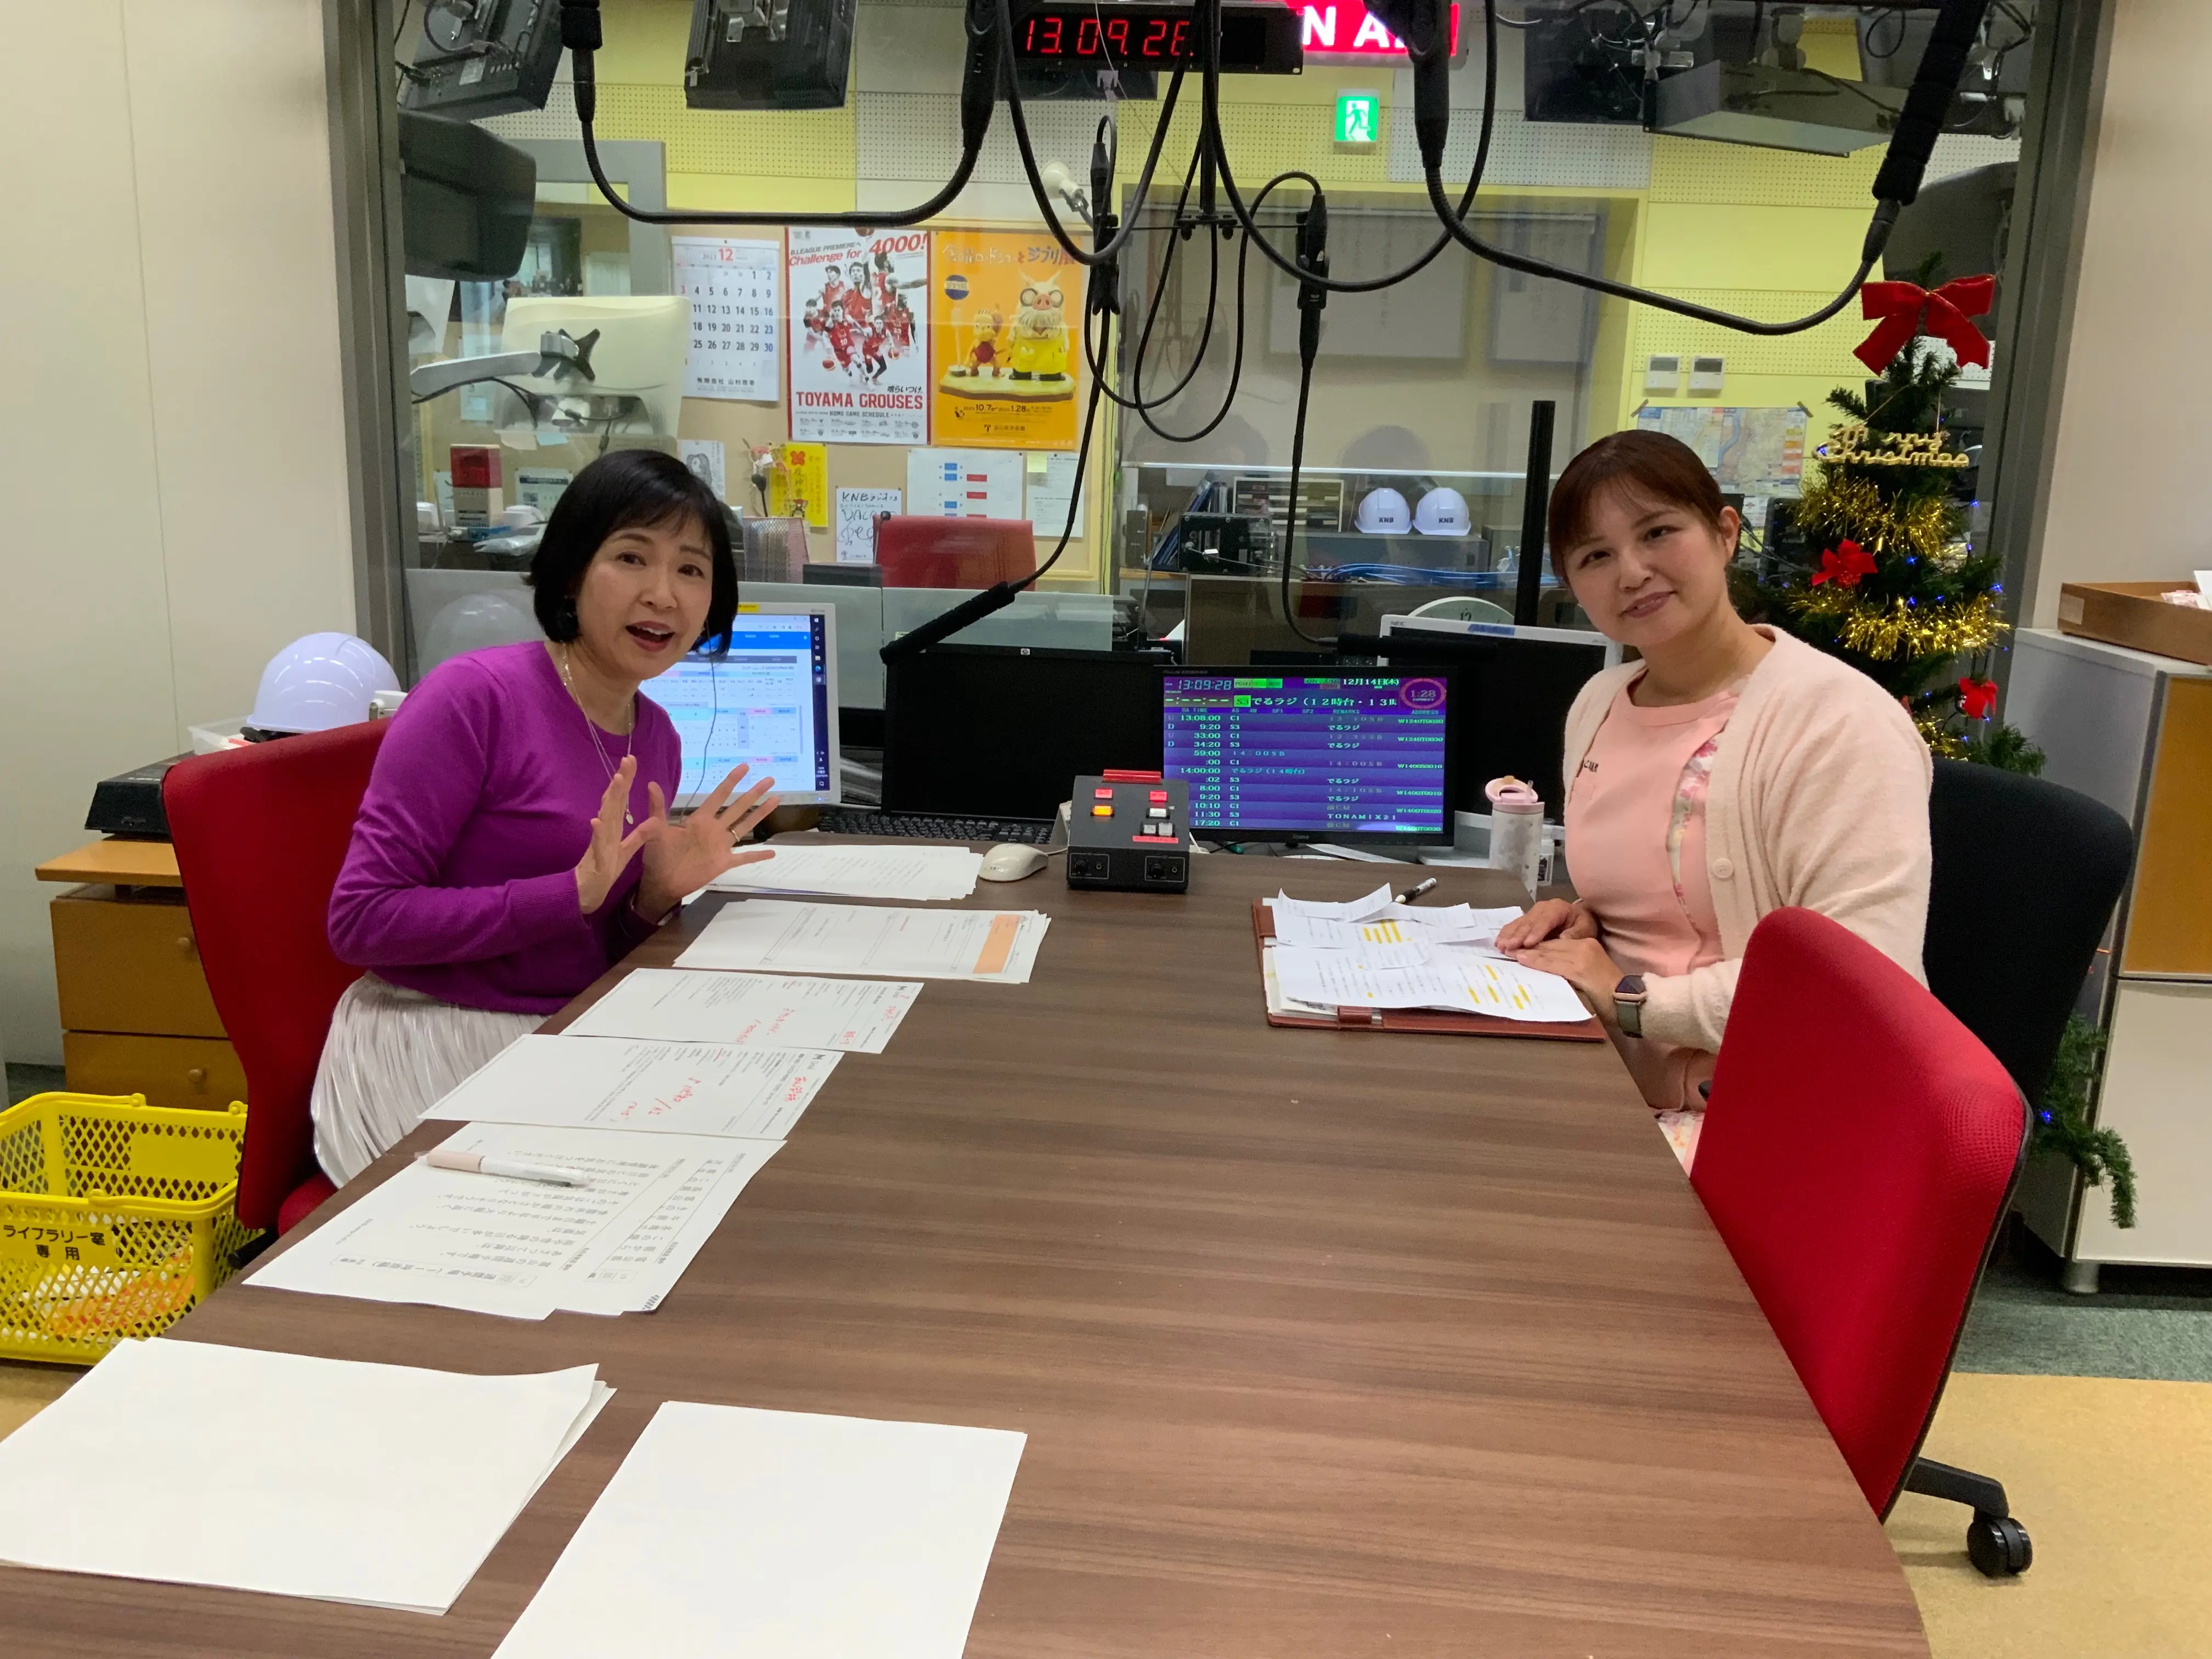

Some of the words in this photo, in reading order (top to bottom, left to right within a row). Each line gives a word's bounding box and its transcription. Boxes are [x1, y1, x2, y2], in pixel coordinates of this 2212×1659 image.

[719, 247, 733, 261] 12
[789, 252, 843, 267] Challenge
[847, 249, 862, 259] for
[869, 233, 928, 256] 4000!
[790, 245, 821, 256] B.LEAGUE
[752, 270, 756, 280] 1
[766, 271, 771, 280] 2
[680, 285, 685, 294] 3
[695, 286, 699, 295] 4
[709, 287, 714, 296] 5
[723, 287, 728, 296] 6
[738, 288, 742, 297] 7
[752, 289, 757, 297] 8
[766, 289, 771, 298] 9
[693, 304, 701, 312] 11
[708, 304, 716, 314] 12
[722, 306, 730, 314] 13
[736, 306, 744, 315] 14
[751, 307, 759, 315] 15
[764, 307, 773, 316] 16
[693, 321, 702, 331] 18
[708, 323, 716, 331] 19
[722, 323, 731, 332] 20
[736, 324, 744, 333] 21
[750, 325, 759, 334] 22
[764, 325, 774, 334] 23
[693, 340, 702, 349] 25
[708, 340, 716, 349] 26
[722, 341, 731, 350] 27
[736, 342, 745, 351] 28
[750, 342, 759, 351] 29
[764, 343, 774, 352] 30
[796, 391, 854, 408] TOYAMA
[859, 393, 923, 410] GROUSES
[1812, 439, 1970, 468] Christmas
[1460, 610, 1472, 622] 12
[1178, 680, 1232, 690] 13:09:28
